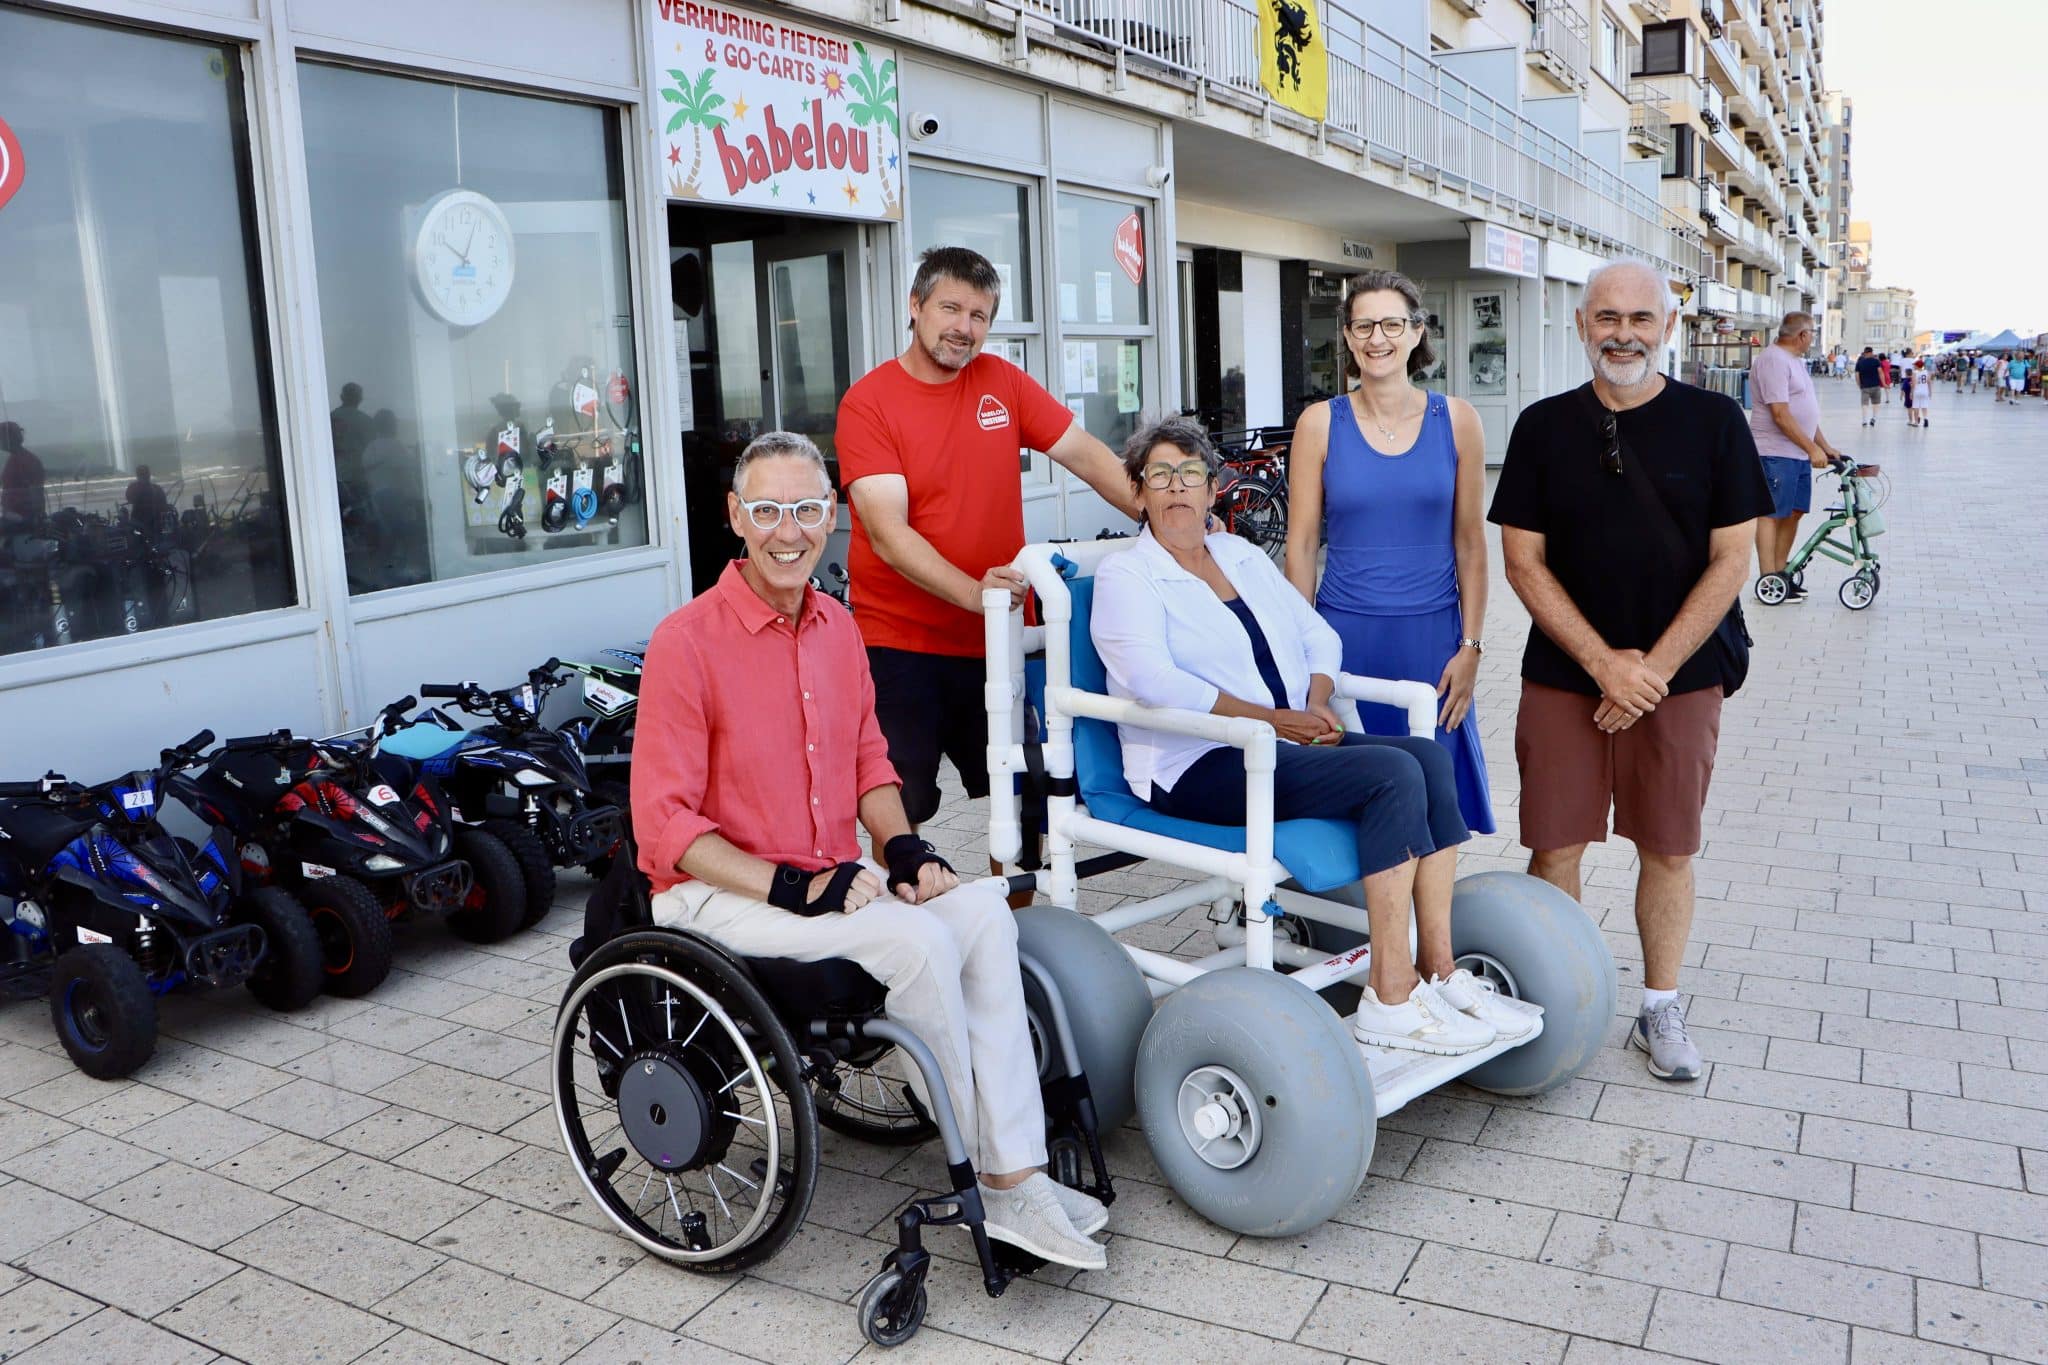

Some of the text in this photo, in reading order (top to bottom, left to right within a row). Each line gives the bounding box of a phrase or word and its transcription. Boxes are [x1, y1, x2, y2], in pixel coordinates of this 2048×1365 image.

[657, 0, 849, 65] VERHURING FIETSEN
[704, 38, 816, 85] & GO-CARTS
[712, 98, 869, 196] babelou
[444, 214, 455, 232] 11
[460, 207, 472, 224] 12
[377, 787, 393, 801] 6
